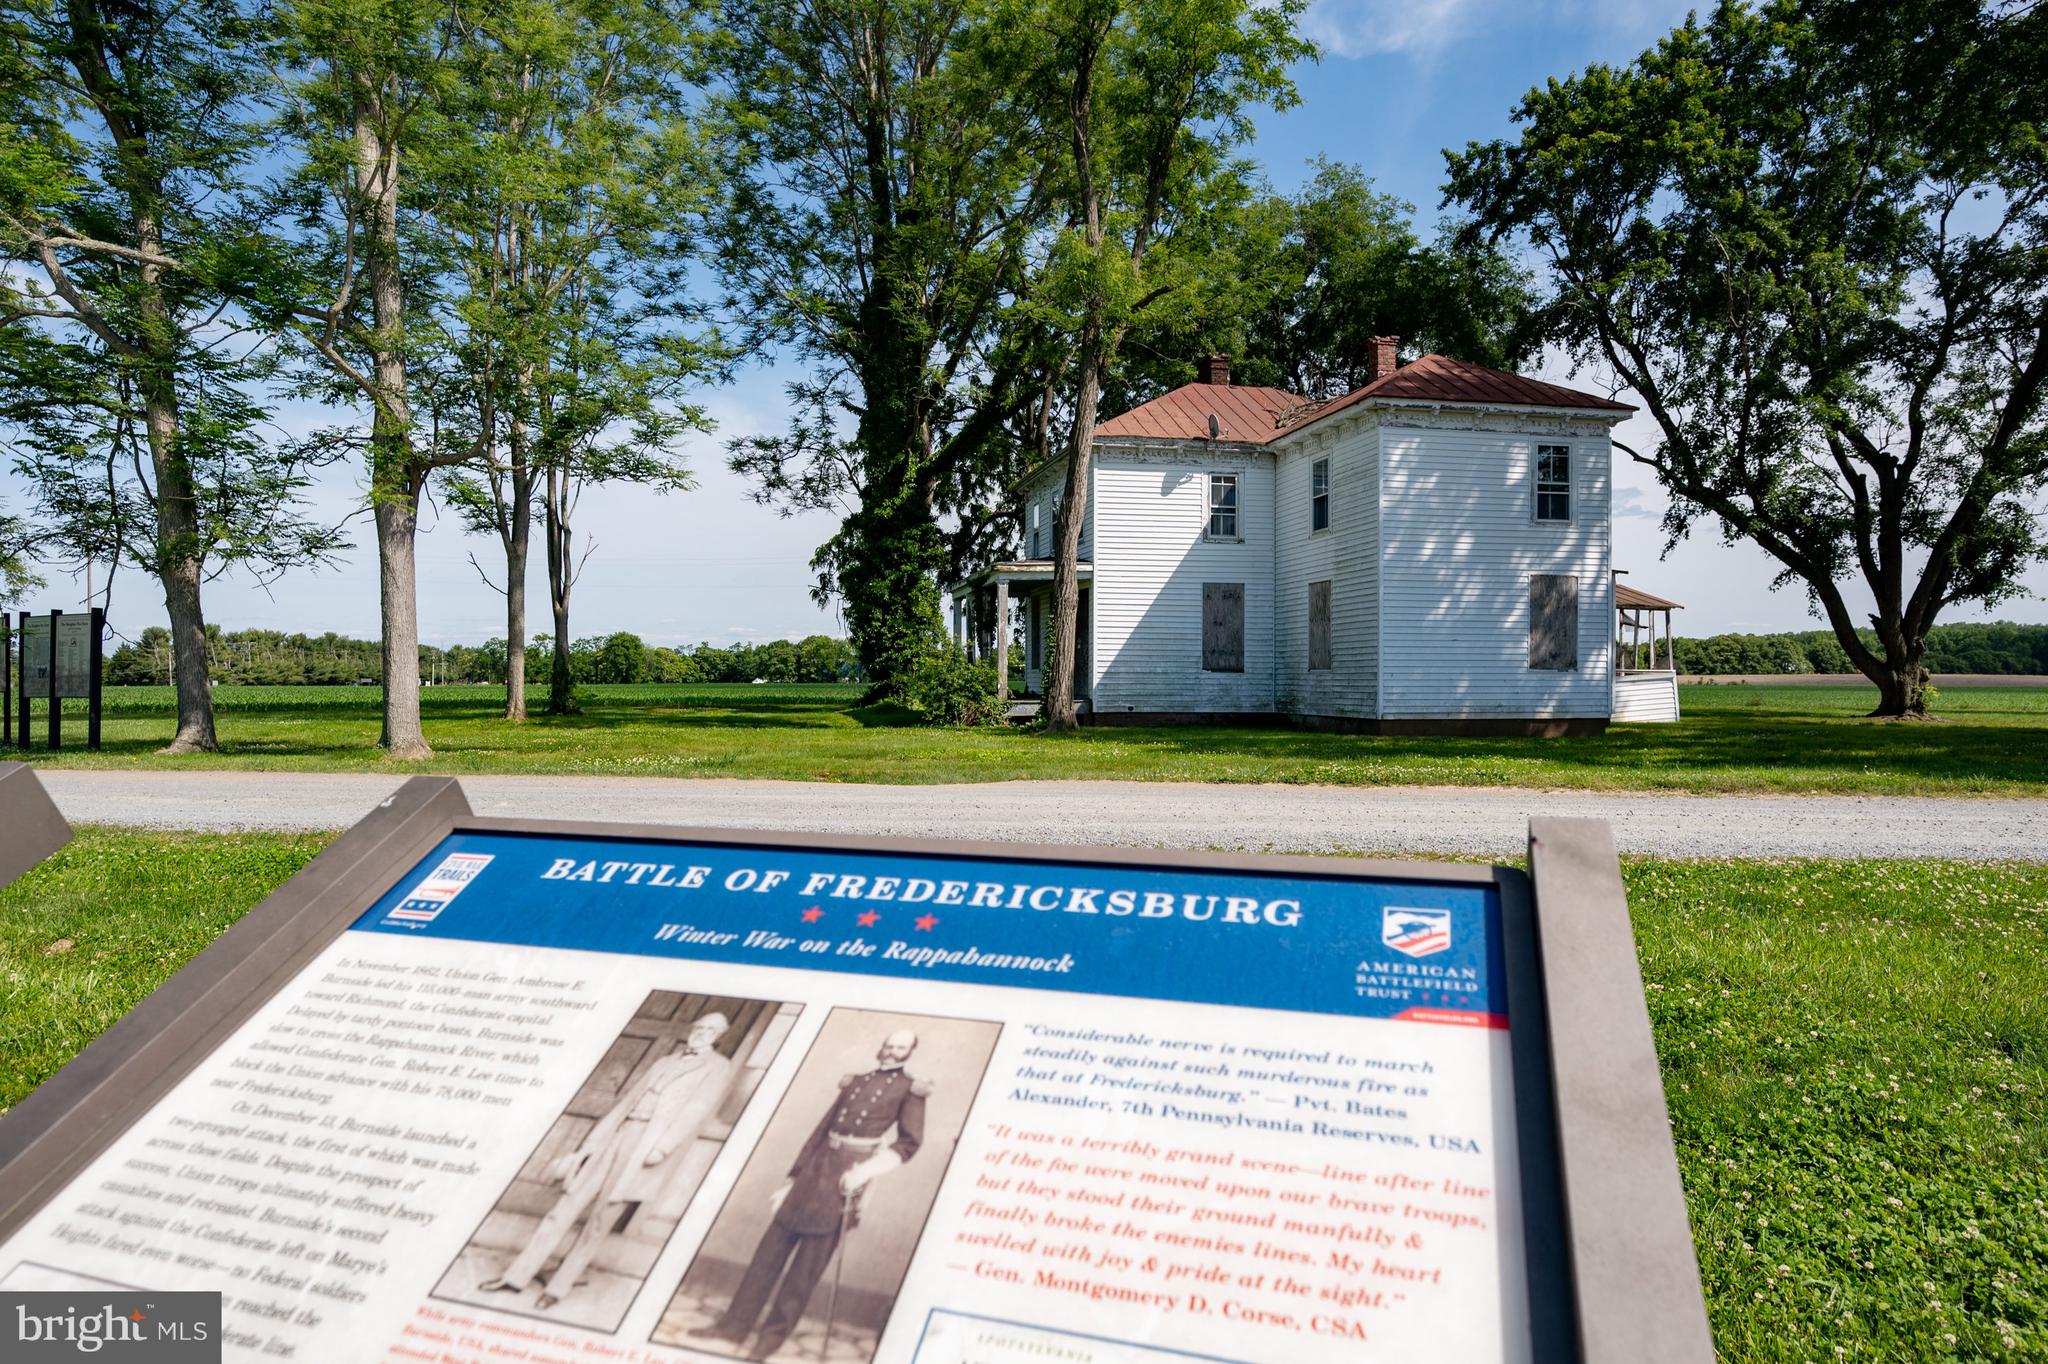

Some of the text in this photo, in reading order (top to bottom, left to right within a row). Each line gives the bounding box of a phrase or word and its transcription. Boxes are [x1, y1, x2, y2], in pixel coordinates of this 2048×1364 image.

[432, 868, 475, 881] TRAILS
[541, 858, 1303, 927] BATTLE OF FREDERICKSBURG
[654, 924, 1075, 974] Winter War on the Rappahannock
[1357, 961, 1476, 979] AMERICAN
[1356, 974, 1477, 992] BATTLEFIELD
[1356, 987, 1412, 999] TRUST
[1023, 1046, 1429, 1097] steadily against such murderous fire as
[1159, 1039, 1214, 1052] nerve
[1219, 1042, 1237, 1055] is
[1242, 1047, 1331, 1064] required
[1336, 1054, 1358, 1066] to
[1364, 1058, 1434, 1074] march
[1008, 1087, 1481, 1155] Alexander, 7th Pennsylvania Reserves, USA
[1015, 1065, 1058, 1081] that
[1061, 1072, 1085, 1084] at
[1293, 1094, 1336, 1112] Pvt.
[1345, 1100, 1408, 1119] Bates
[984, 1149, 1488, 1230] of the foe were moved upon our brave troops,
[1016, 1130, 1057, 1145] was
[1060, 1136, 1075, 1148] a
[1080, 1136, 1161, 1160] terribly
[1164, 1149, 1236, 1167] grand
[1373, 1172, 1435, 1192] after
[1442, 1178, 1491, 1199] line
[975, 1172, 1423, 1250] but they stood their ground manfully &
[955, 1231, 1038, 1255] swelled
[1041, 1244, 1093, 1263] with
[1093, 1249, 1134, 1273] joy
[1140, 1256, 1158, 1273] &
[1164, 1263, 1232, 1285] pride
[1237, 1273, 1266, 1291] at
[1272, 1276, 1312, 1297] the
[963, 1200, 1442, 1285] finally broke the enemies lines. My heart
[974, 1260, 1024, 1284] Gen.
[1033, 1268, 1180, 1313] Montgomery
[1188, 1294, 1212, 1314] D.
[1221, 1299, 1301, 1332] Corse,
[1309, 1315, 1367, 1341] CSA
